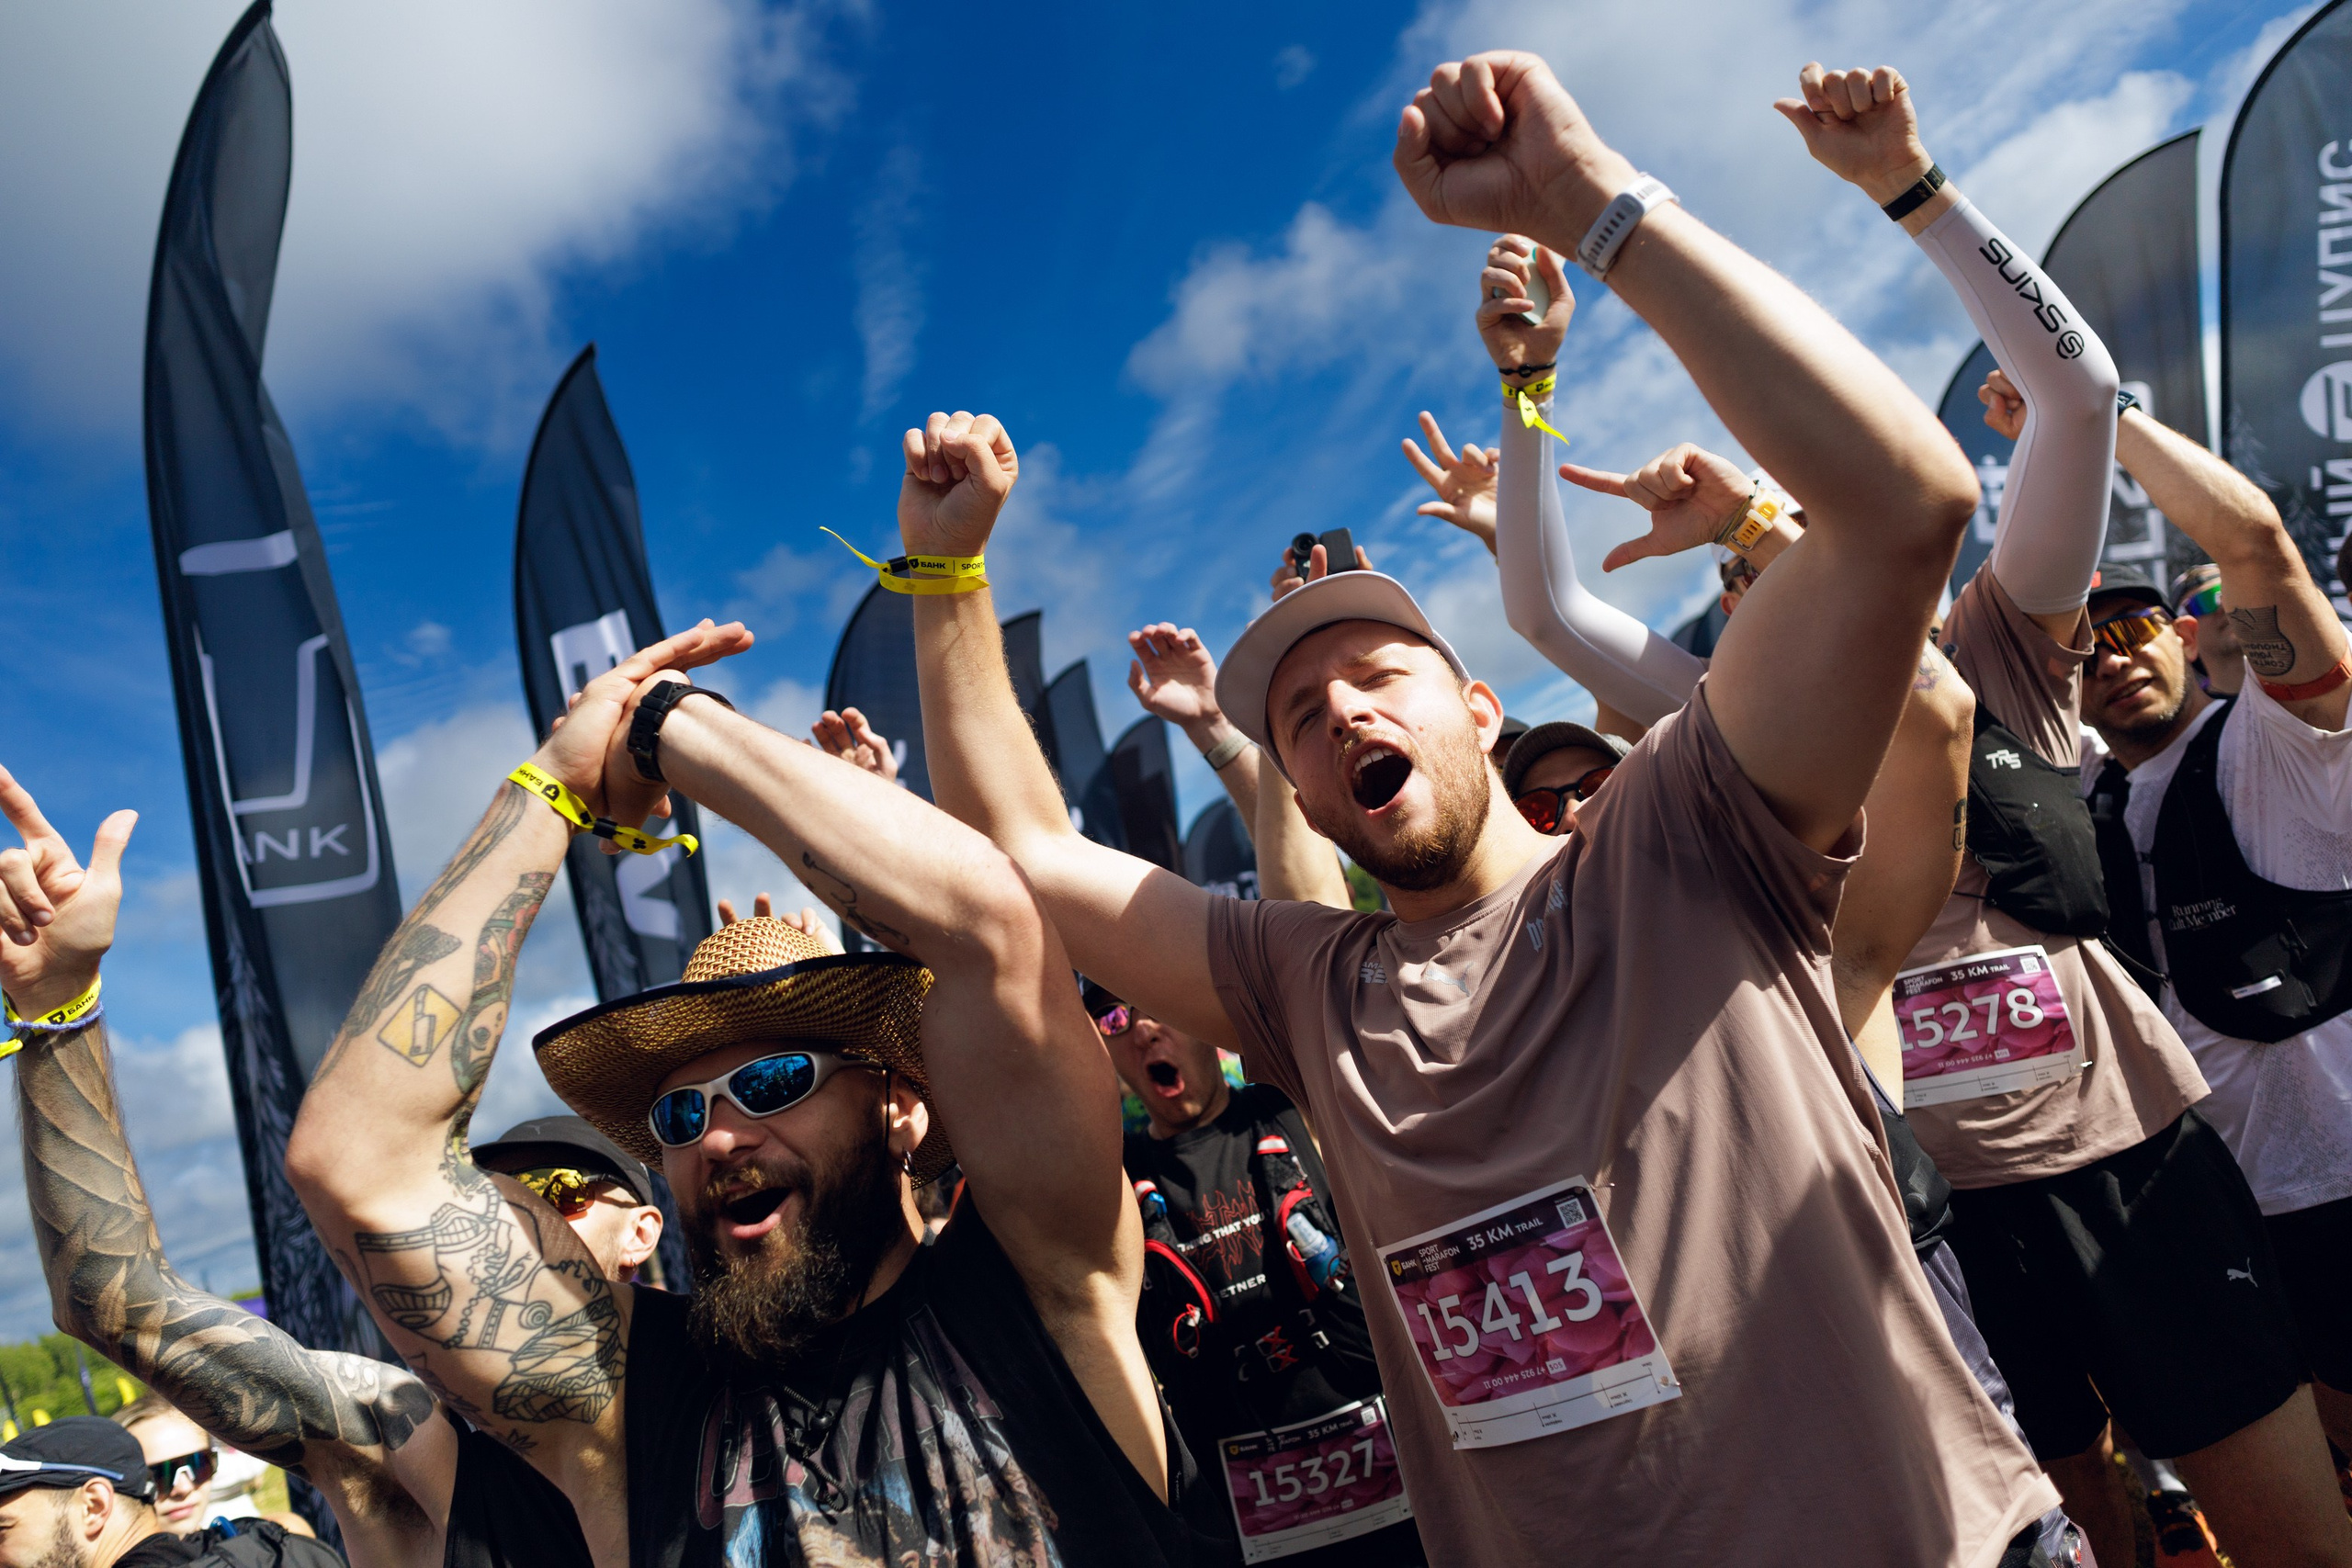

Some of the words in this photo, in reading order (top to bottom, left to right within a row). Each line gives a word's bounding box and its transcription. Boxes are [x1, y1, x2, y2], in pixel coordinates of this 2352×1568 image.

[1979, 237, 2067, 333] SKINS
[921, 561, 945, 570] БАНК
[1985, 750, 2021, 769] TRS
[516, 769, 543, 786] БАНК
[240, 824, 349, 864] NK
[1950, 970, 1965, 981] 35
[1968, 965, 1989, 977] KM
[1990, 964, 2010, 973] TRAIL
[1905, 987, 1922, 996] FEST
[67, 994, 94, 1015] БАНК
[1213, 1222, 1241, 1239] THAT
[1466, 1234, 1486, 1251] 35
[1487, 1223, 1514, 1244] KM
[1515, 1217, 1544, 1234] TRAIL
[1419, 1244, 1439, 1258] SPORT
[1401, 1258, 1418, 1269] БАНК
[1425, 1261, 1440, 1273] FEST
[1416, 1250, 1603, 1361] 15413
[1521, 1369, 1535, 1379] 925
[1536, 1366, 1546, 1375] +7
[1491, 1377, 1503, 1387] 00
[1503, 1372, 1520, 1384] 444
[1483, 1381, 1491, 1390] 11
[1321, 1423, 1339, 1436] KM
[1250, 1438, 1374, 1507] 15327
